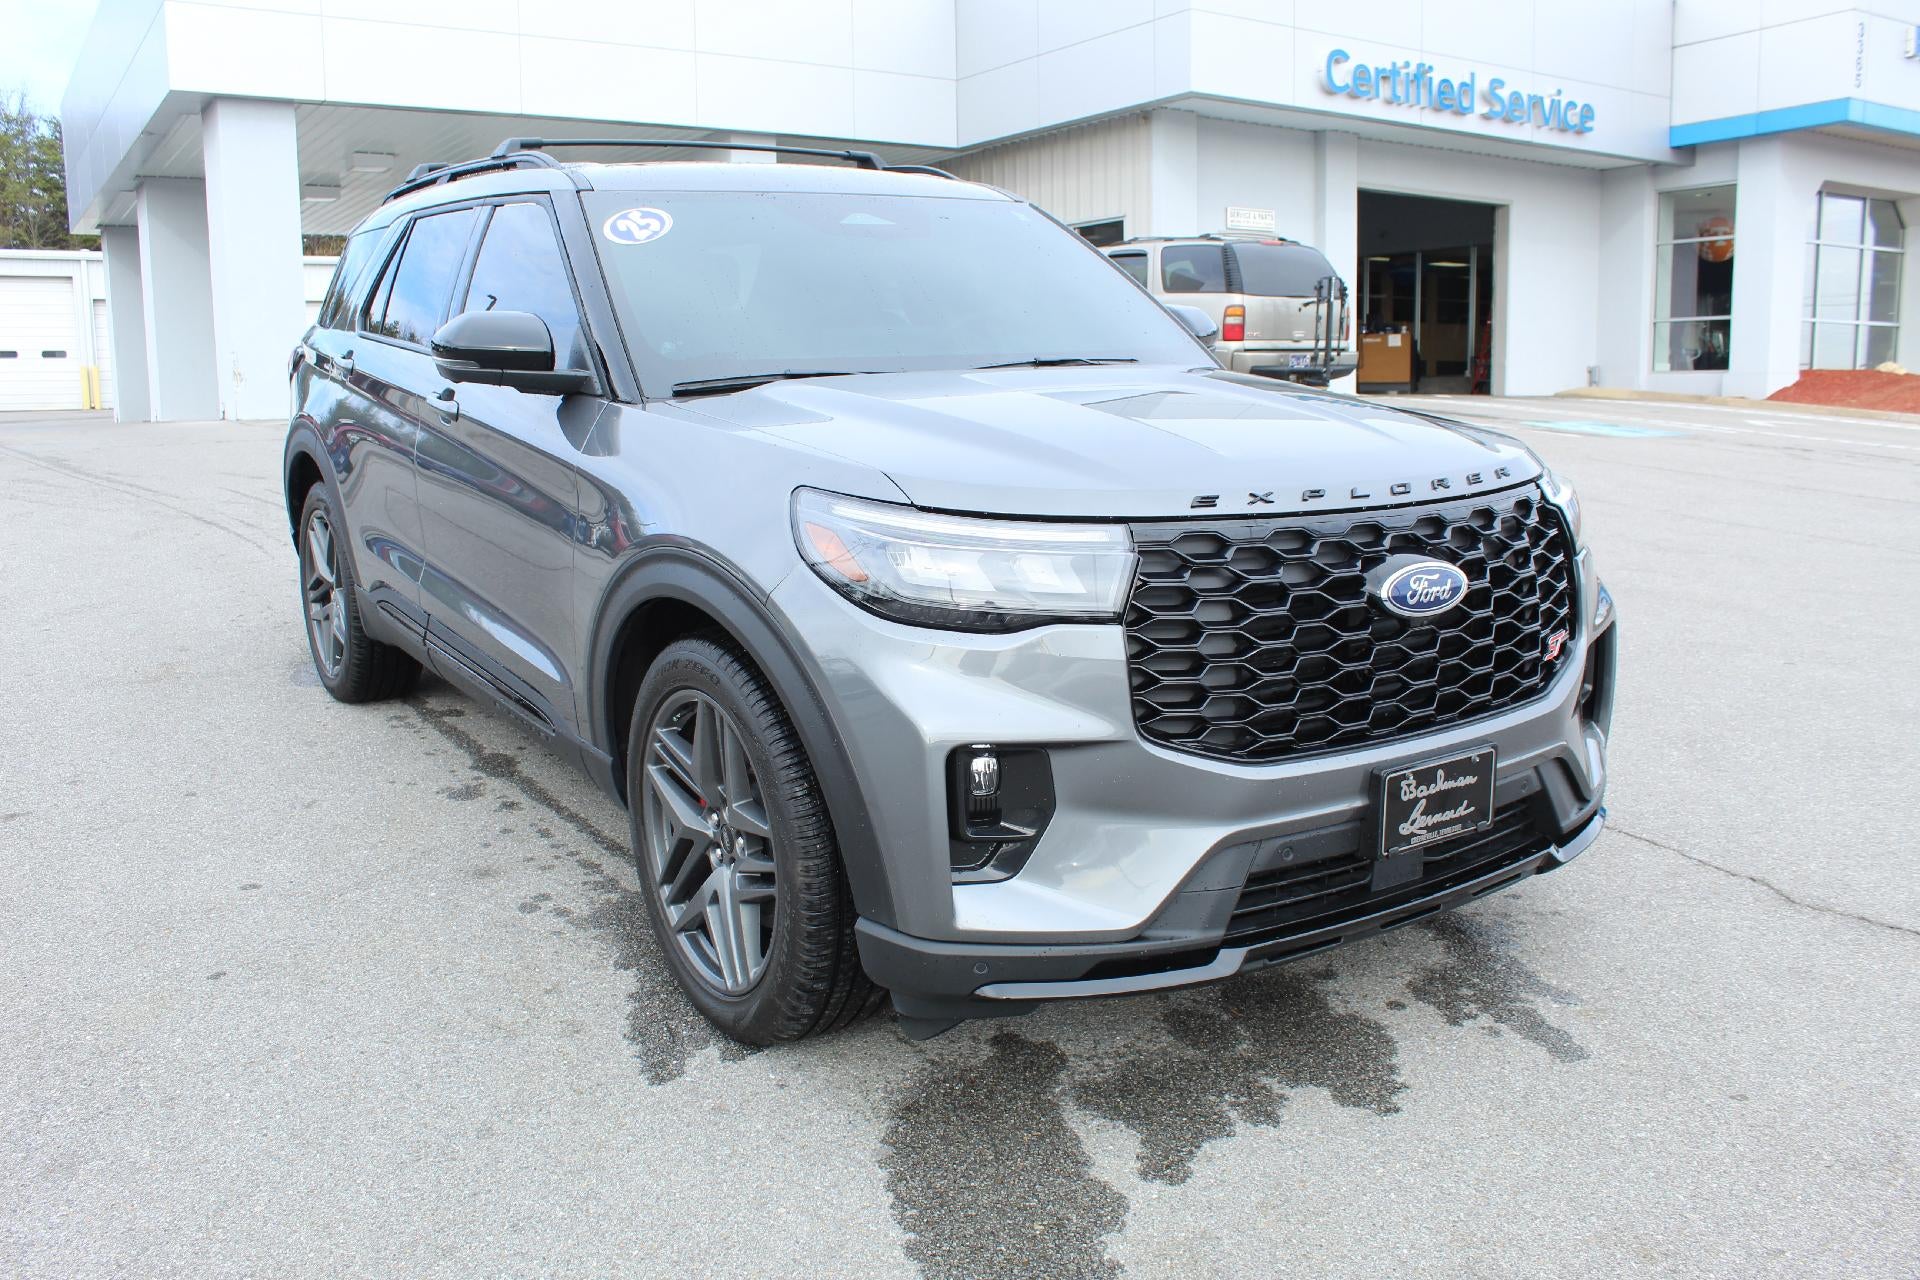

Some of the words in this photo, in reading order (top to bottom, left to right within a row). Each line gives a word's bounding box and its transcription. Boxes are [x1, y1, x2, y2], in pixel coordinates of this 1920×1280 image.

[1325, 49, 1476, 114] Certified
[1487, 77, 1595, 133] Service
[616, 209, 661, 240] 25
[1190, 466, 1511, 508] EXPLORER
[1406, 573, 1452, 605] Ford
[1401, 768, 1478, 801] Bachman
